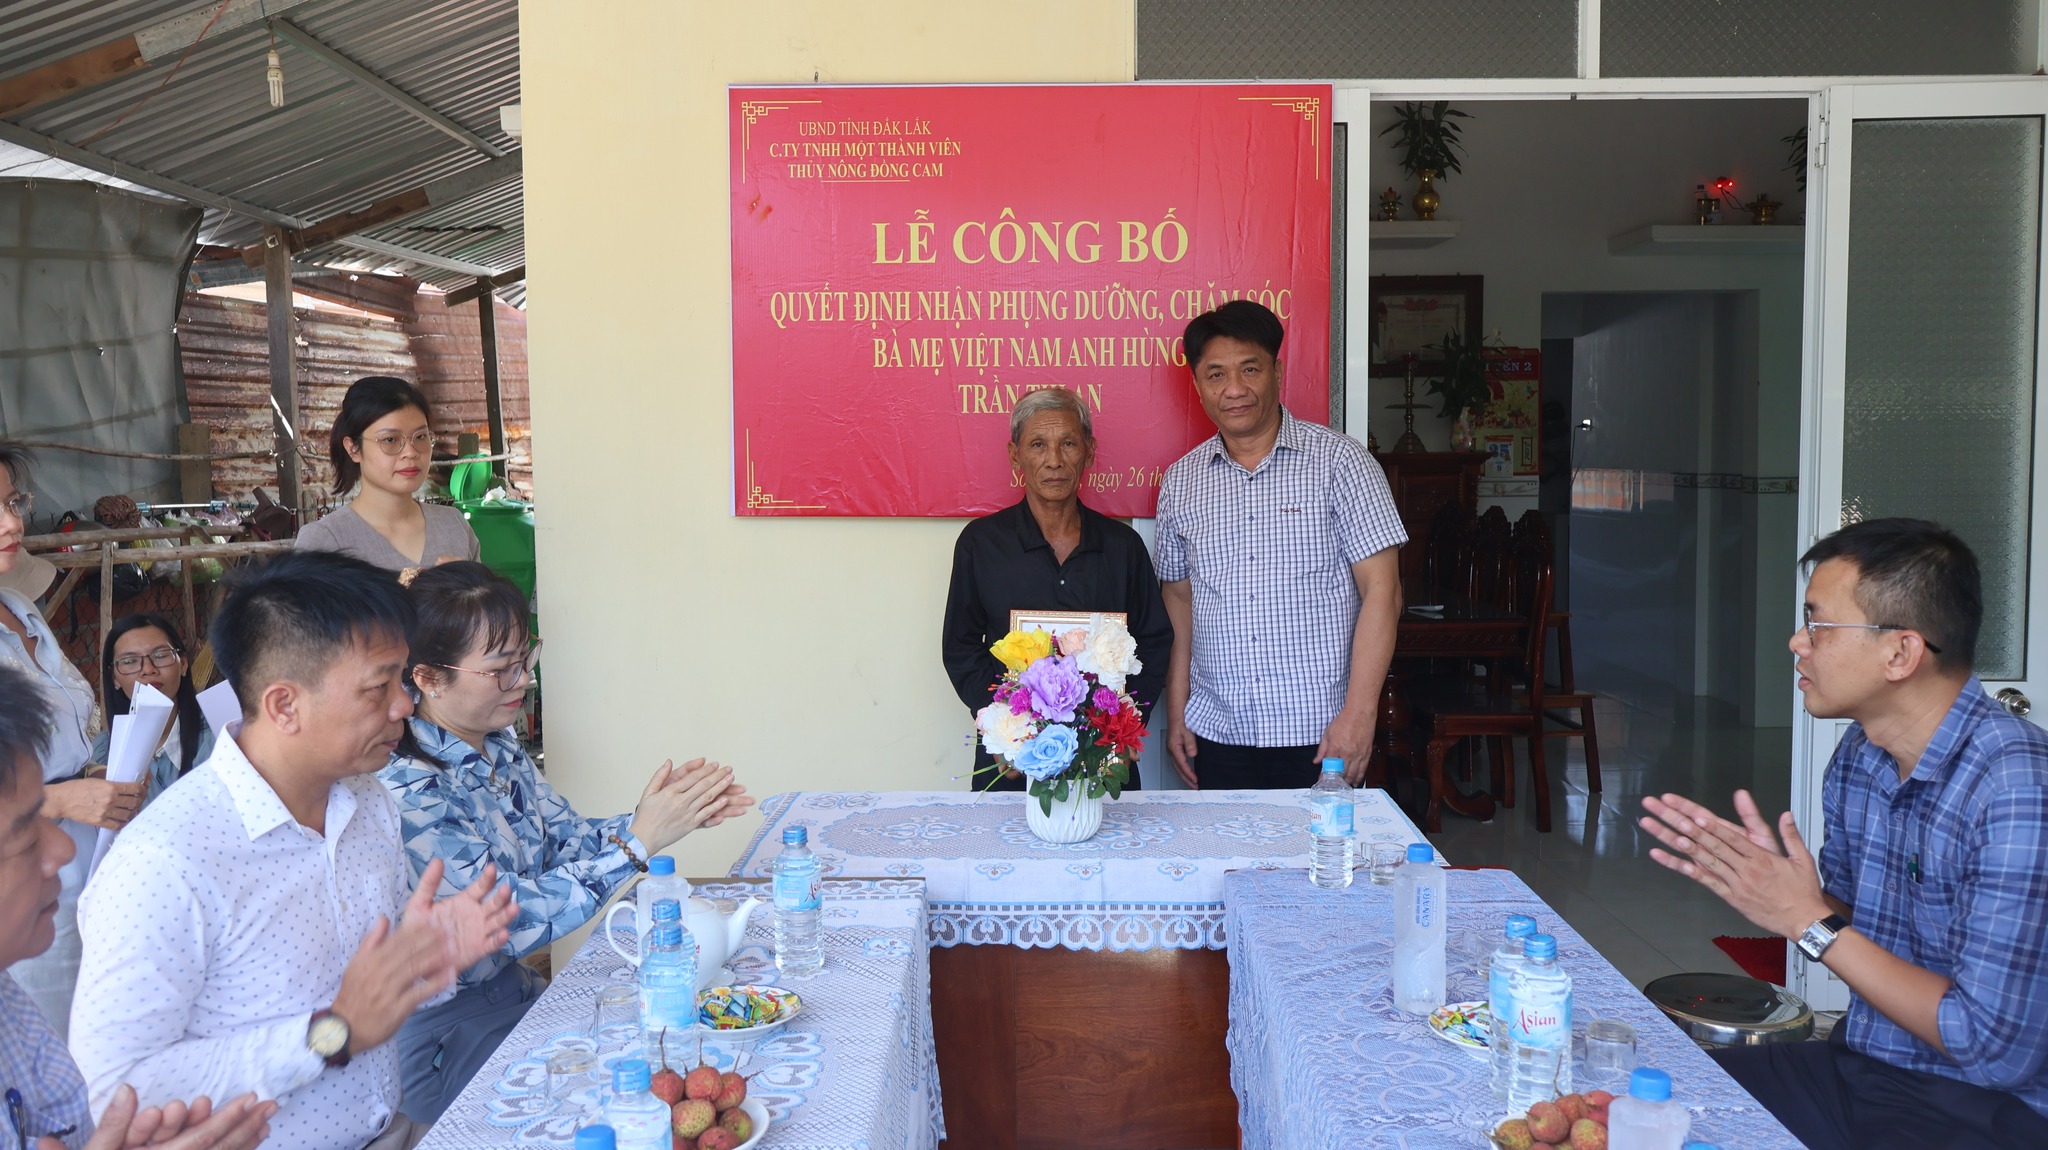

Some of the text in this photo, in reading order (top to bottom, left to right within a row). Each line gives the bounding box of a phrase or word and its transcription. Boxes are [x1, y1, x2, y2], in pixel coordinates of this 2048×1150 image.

[799, 121, 836, 136] UBND
[838, 117, 870, 136] TỈNH
[769, 137, 961, 160] C.TY TNHH MỘT THÀNH VIÊN
[787, 159, 944, 178] THỦY NÔNG ĐỒNG CAM
[871, 207, 1189, 264] LỄ CÔNG BỐ
[770, 282, 848, 329] QUYẾT
[854, 291, 911, 330] ĐỊNH
[917, 286, 982, 329] NHẬN
[988, 290, 1068, 329] PHỤNG
[1074, 281, 1164, 326] DƯỠNG,
[873, 328, 1187, 376] BÀ MẸ VIỆT NAM ANH HÙNG
[958, 375, 1019, 414] TRẦN
[1088, 466, 1123, 493] ngày
[1127, 466, 1145, 488] 26
[1422, 886, 1431, 928] CANARY
[1512, 1008, 1556, 1034] Asian
